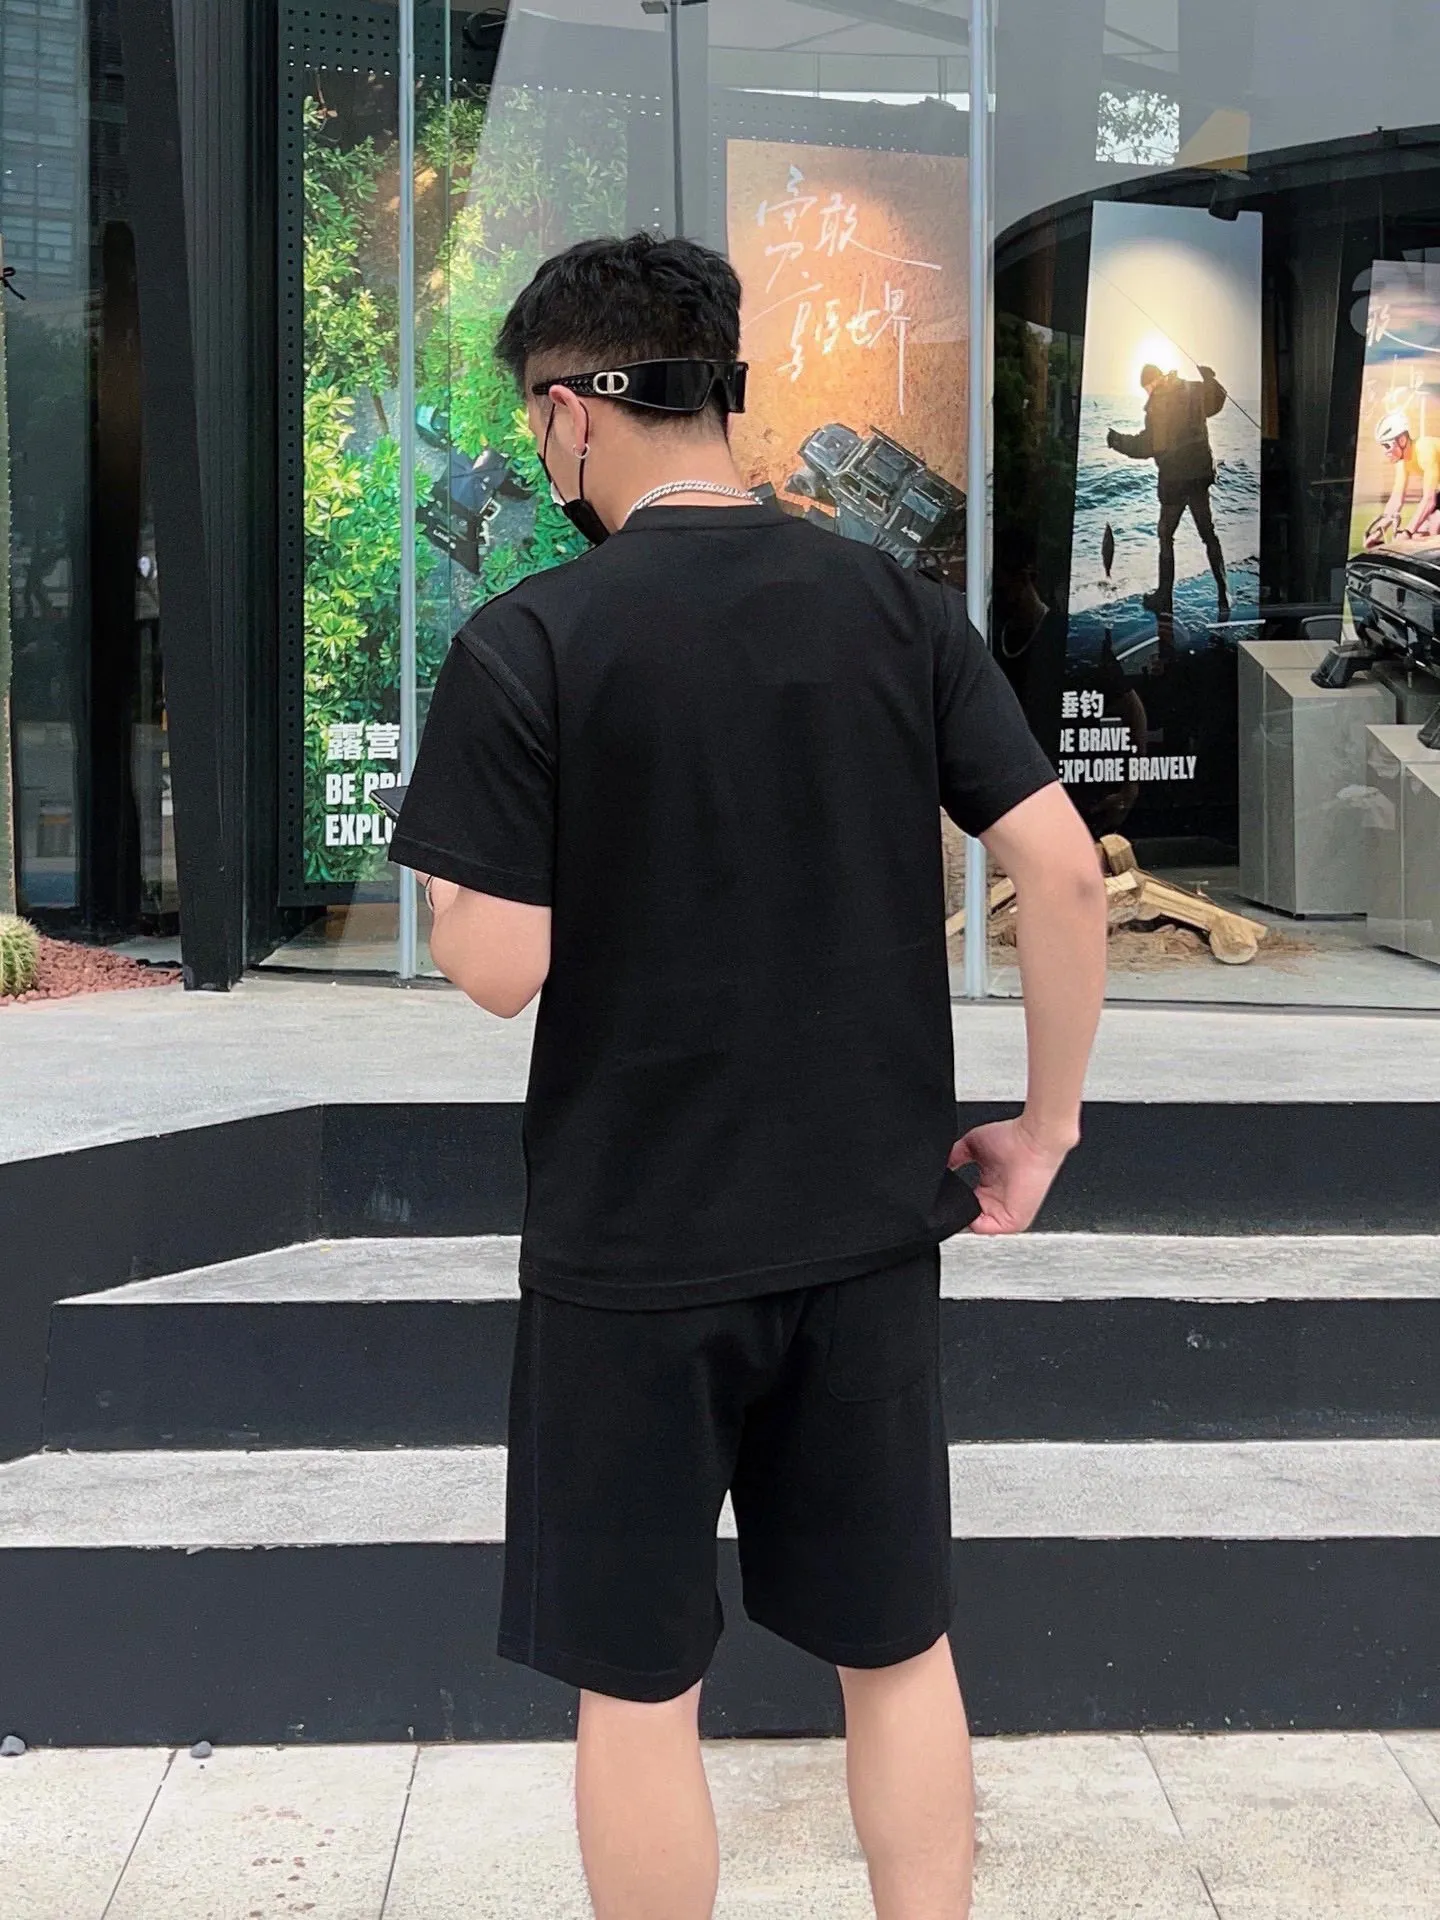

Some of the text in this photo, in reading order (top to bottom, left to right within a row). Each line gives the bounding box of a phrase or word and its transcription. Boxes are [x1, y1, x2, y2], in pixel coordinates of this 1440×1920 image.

[327, 720, 400, 761] 露营
[1079, 727, 1138, 754] BRAVE,
[1128, 755, 1197, 781] BRAVELY
[325, 773, 356, 805] BE
